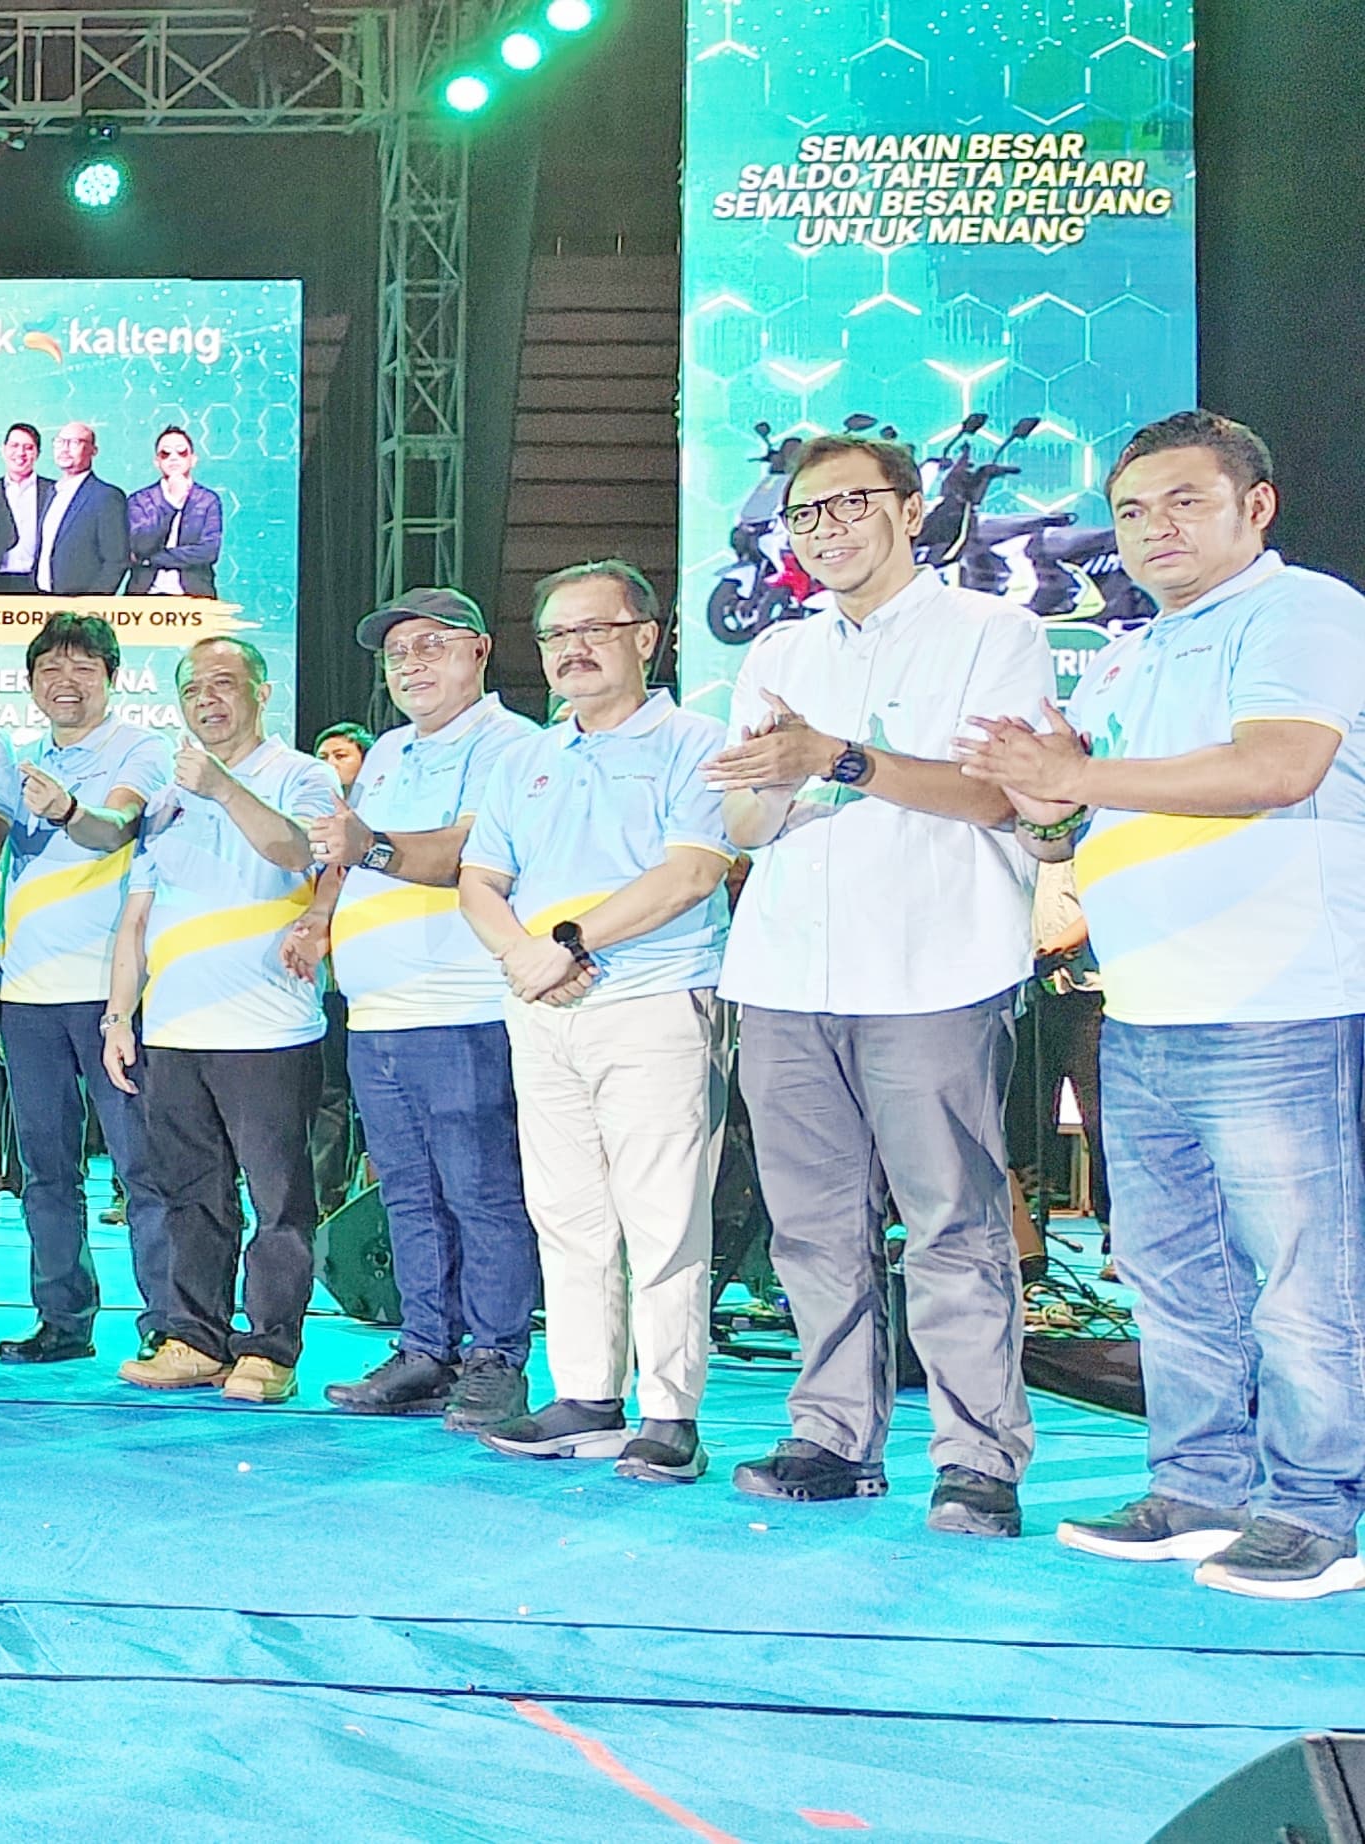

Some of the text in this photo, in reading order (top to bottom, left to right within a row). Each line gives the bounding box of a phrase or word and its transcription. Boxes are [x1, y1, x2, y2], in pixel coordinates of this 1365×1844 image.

[797, 133, 1086, 162] SEMAKIN BESAR
[739, 160, 1146, 191] SALDO TAHETA PAHARI
[712, 187, 1171, 219] SEMAKIN BESAR PELUANG
[796, 216, 1086, 246] UNTUK MENANG
[68, 317, 222, 365] kalteng
[150, 611, 203, 626] ORYS
